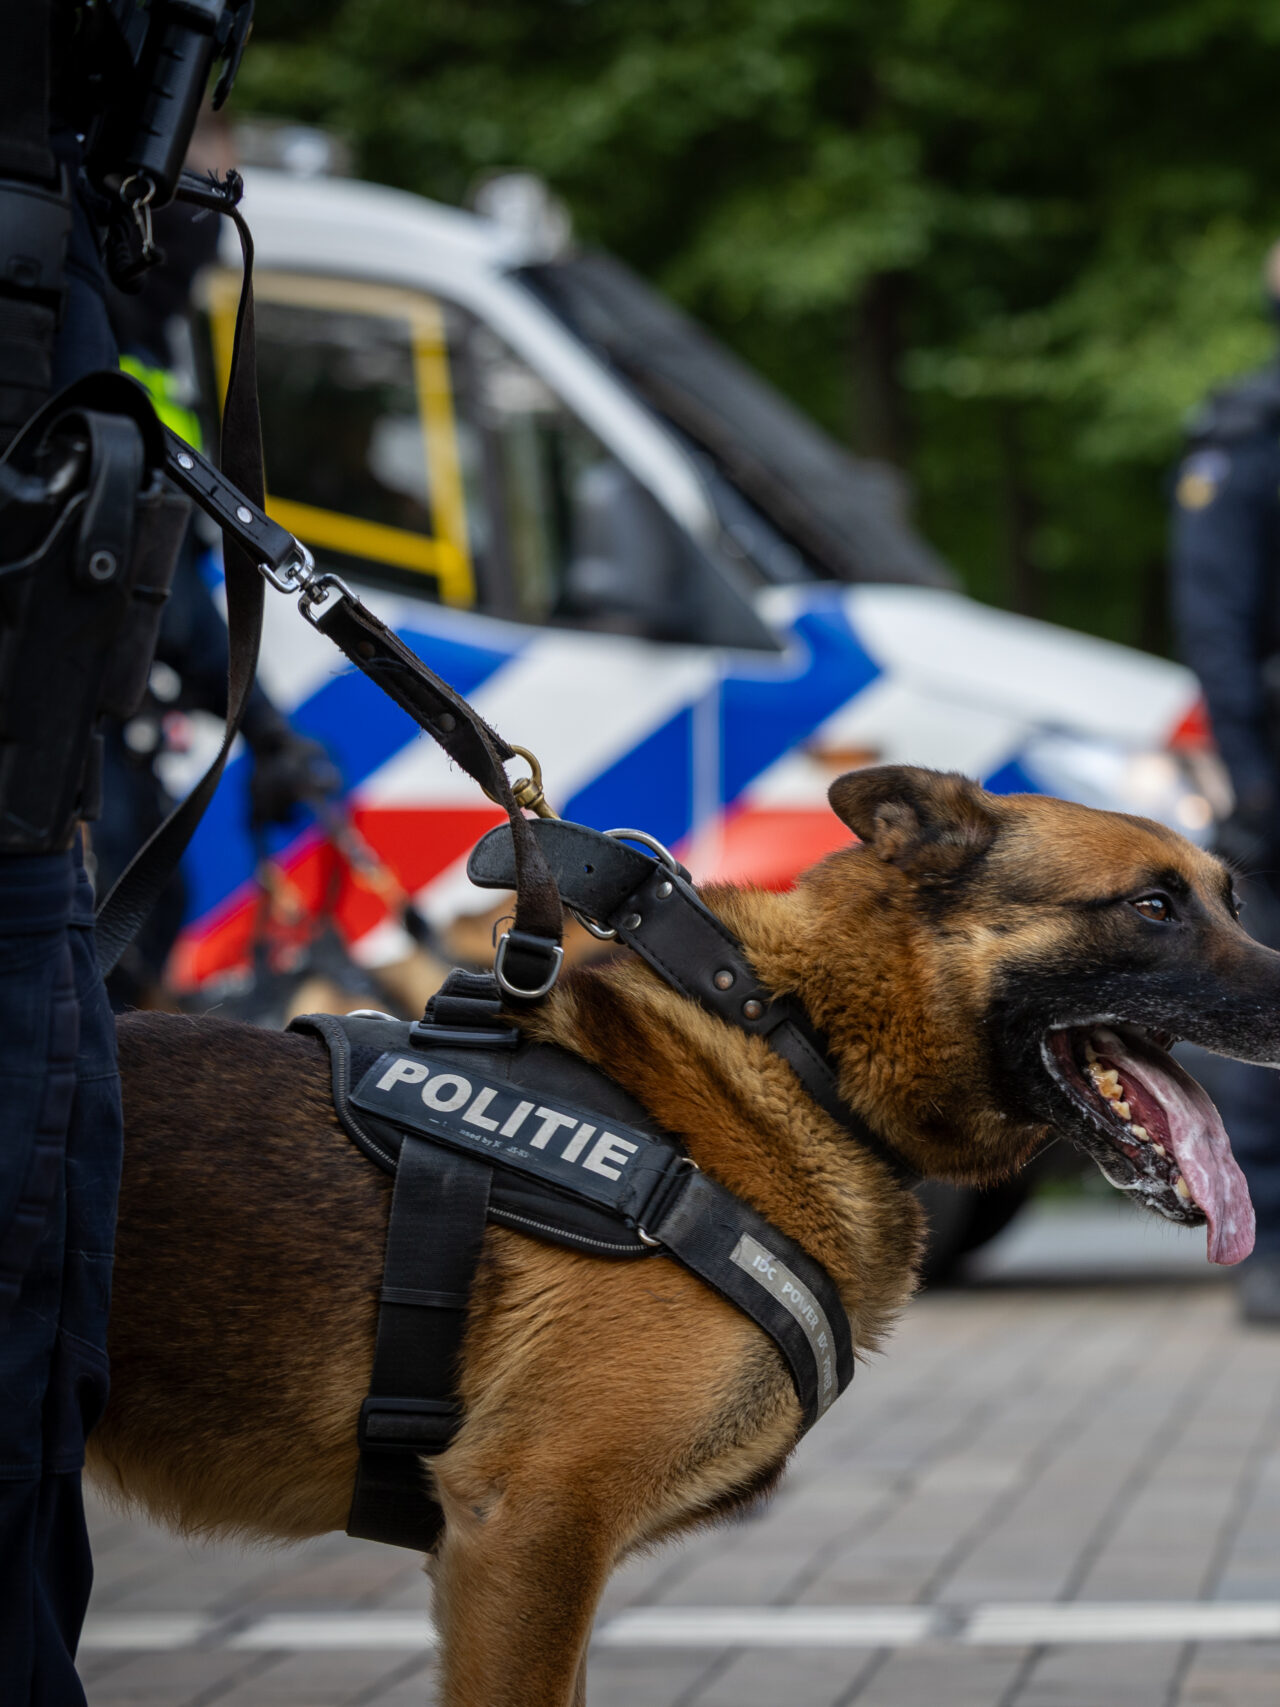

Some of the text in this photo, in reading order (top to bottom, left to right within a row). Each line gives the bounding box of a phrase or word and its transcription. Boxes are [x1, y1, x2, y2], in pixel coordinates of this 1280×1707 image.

[376, 1058, 639, 1182] POLITIE
[752, 1255, 777, 1281] IDC
[781, 1281, 820, 1331] POWER
